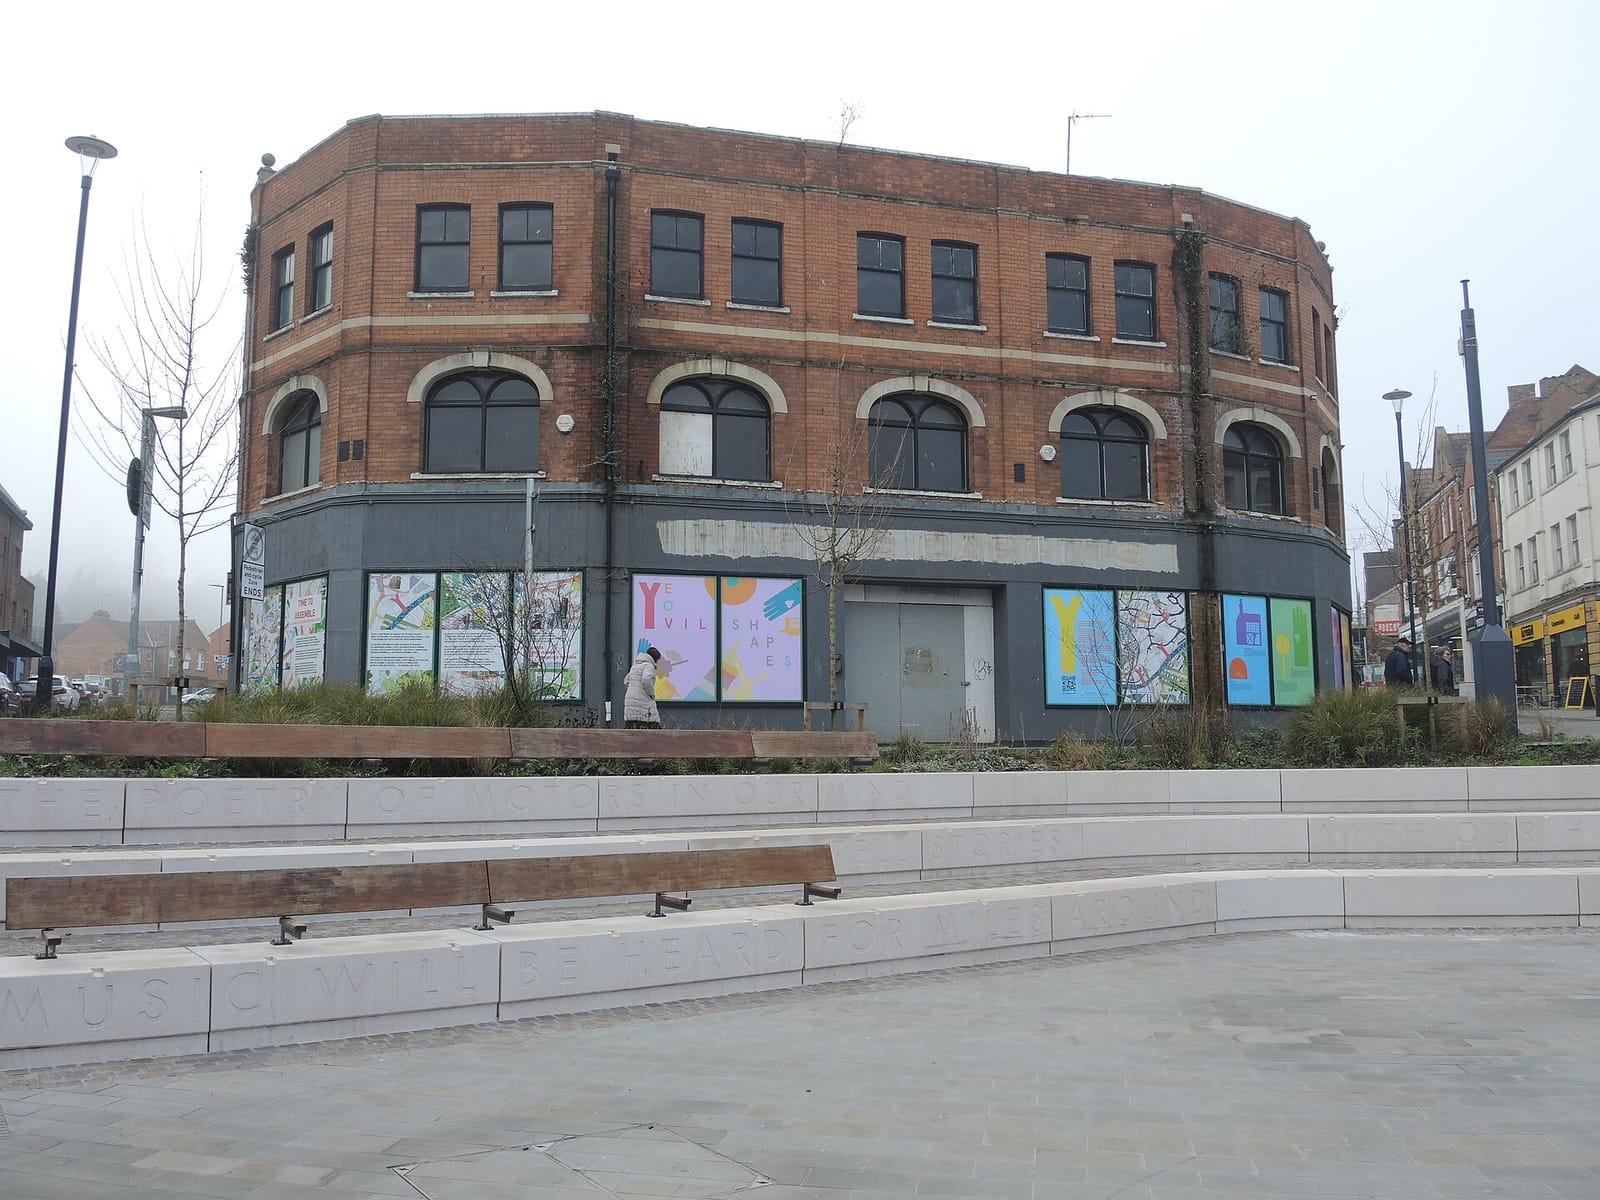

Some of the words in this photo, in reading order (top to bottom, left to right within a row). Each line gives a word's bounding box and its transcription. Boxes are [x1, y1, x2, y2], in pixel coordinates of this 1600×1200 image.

[244, 586, 262, 597] ENDS
[141, 785, 344, 818] POETRY
[377, 784, 435, 814] OF
[471, 783, 645, 812] MOTORS
[3, 971, 264, 1031] MUSIC
[314, 952, 476, 998] WILL
[519, 944, 579, 990] BE
[616, 928, 788, 974] HEARD
[821, 918, 905, 953] FOR
[1071, 889, 1205, 927] AROUND
